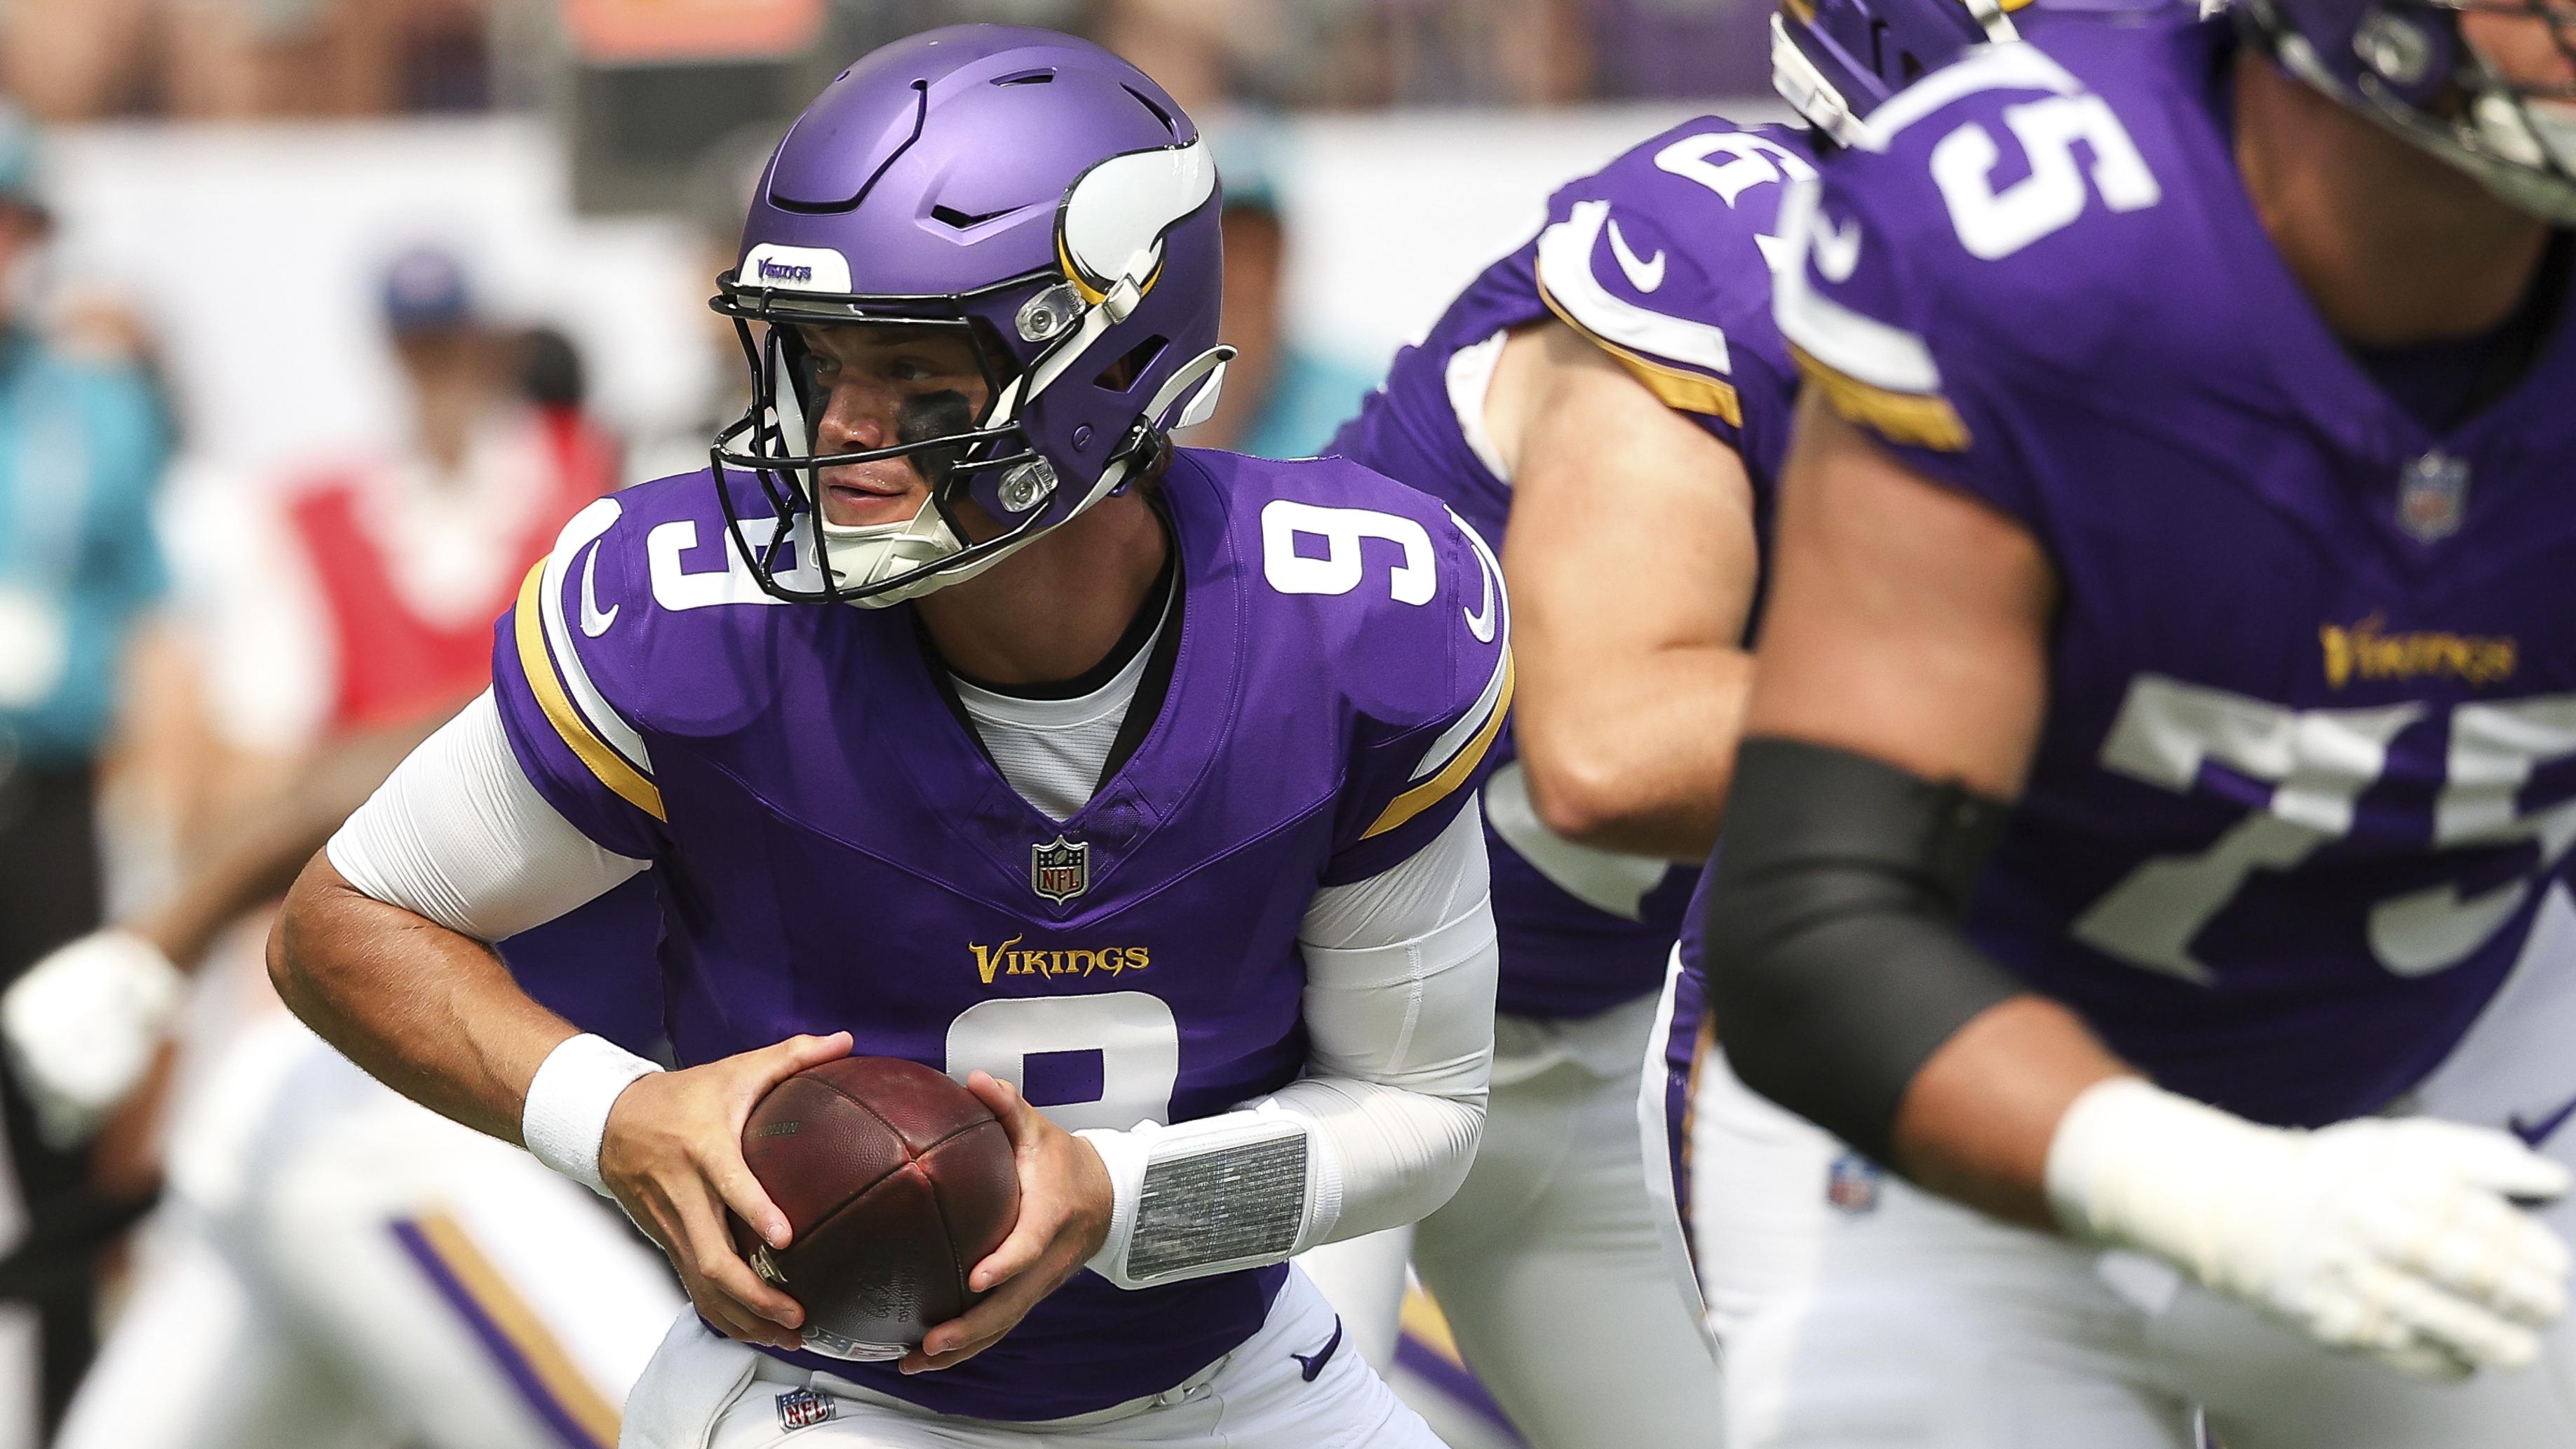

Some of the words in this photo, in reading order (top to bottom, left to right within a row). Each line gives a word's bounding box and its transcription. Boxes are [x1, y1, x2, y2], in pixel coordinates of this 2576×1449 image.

[1260, 499, 1438, 607] 9
[2071, 672, 2576, 985] 75
[1041, 867, 1080, 891] NFL
[785, 1399, 826, 1425] NFL
